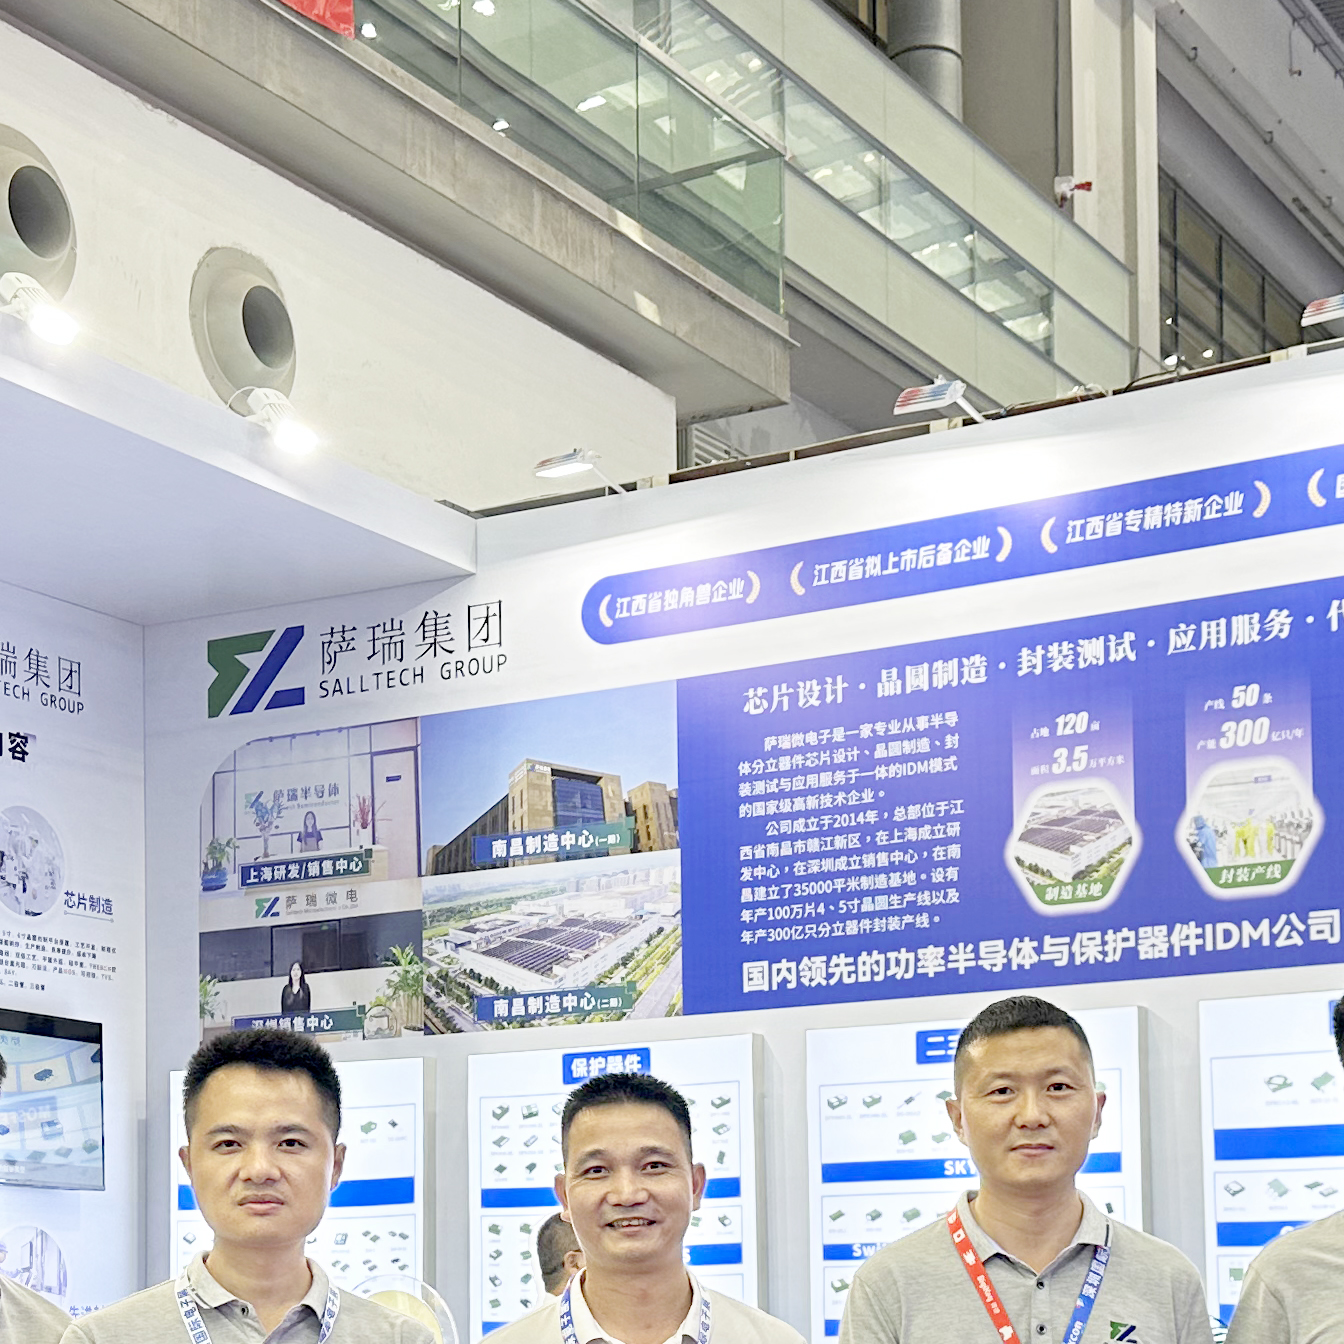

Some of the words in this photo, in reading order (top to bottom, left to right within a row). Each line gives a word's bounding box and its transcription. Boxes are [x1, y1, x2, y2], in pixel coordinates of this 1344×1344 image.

[1066, 490, 1244, 545] 江西省专精特新企业
[813, 535, 990, 587] 江西省拟上市后备企业
[615, 577, 745, 619] 江西省独角兽企业
[319, 600, 504, 676] 萨瑞集团
[319, 665, 424, 699] SALLTECH
[439, 653, 508, 680] GROUP
[40, 692, 85, 715] GROUP
[1231, 683, 1260, 709] 50
[764, 711, 959, 752] 萨瑞微电子是一家专业从事半导
[1055, 711, 1089, 736] 120
[1219, 716, 1271, 749] 300
[1051, 745, 1089, 775] 3.5
[738, 756, 958, 797] 装测试与应用服务于一体的IDM模式
[246, 856, 363, 884] 上海研发/销售中心
[1219, 864, 1282, 884] 封装产线
[64, 890, 114, 915] 芯片制造
[1044, 882, 1103, 901] 制造基地
[741, 909, 1343, 993] 国内领先的功率半导体与保护器件IDM公司
[571, 1053, 642, 1078] 保护器件
